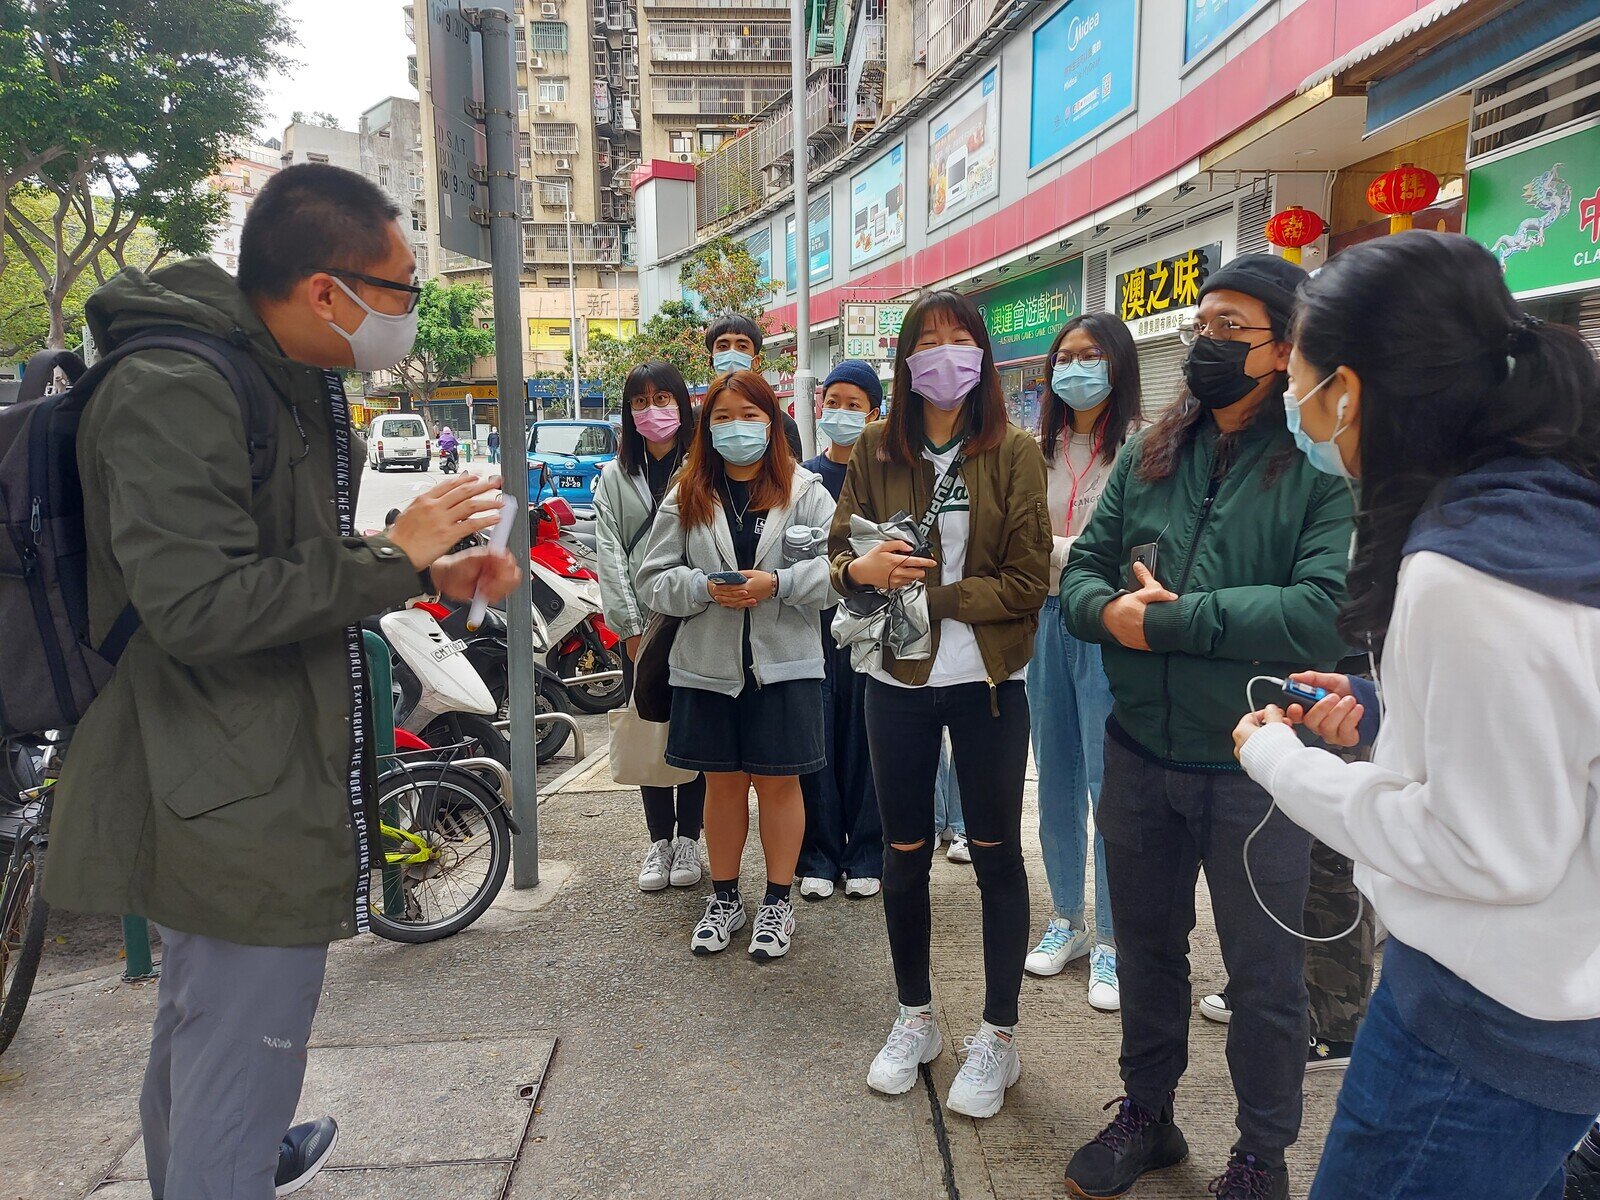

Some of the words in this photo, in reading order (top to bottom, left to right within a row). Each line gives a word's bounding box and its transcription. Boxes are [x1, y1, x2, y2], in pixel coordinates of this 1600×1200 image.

[1067, 12, 1099, 51] Midea
[1122, 249, 1199, 320] 澳之味
[587, 292, 611, 316] 新
[991, 284, 1077, 336] 澳運會遊戲中心
[325, 375, 341, 392] THE
[330, 393, 347, 425] WORLD
[336, 429, 349, 486] EXPLORING
[338, 491, 349, 510] THE
[349, 642, 362, 678] WORLD
[353, 684, 364, 744] EXPLORING
[351, 746, 363, 766] THE
[350, 768, 362, 806] WORLD
[353, 811, 369, 870] EXPLORING
[357, 872, 369, 893] THE
[356, 895, 371, 933] WORLD
